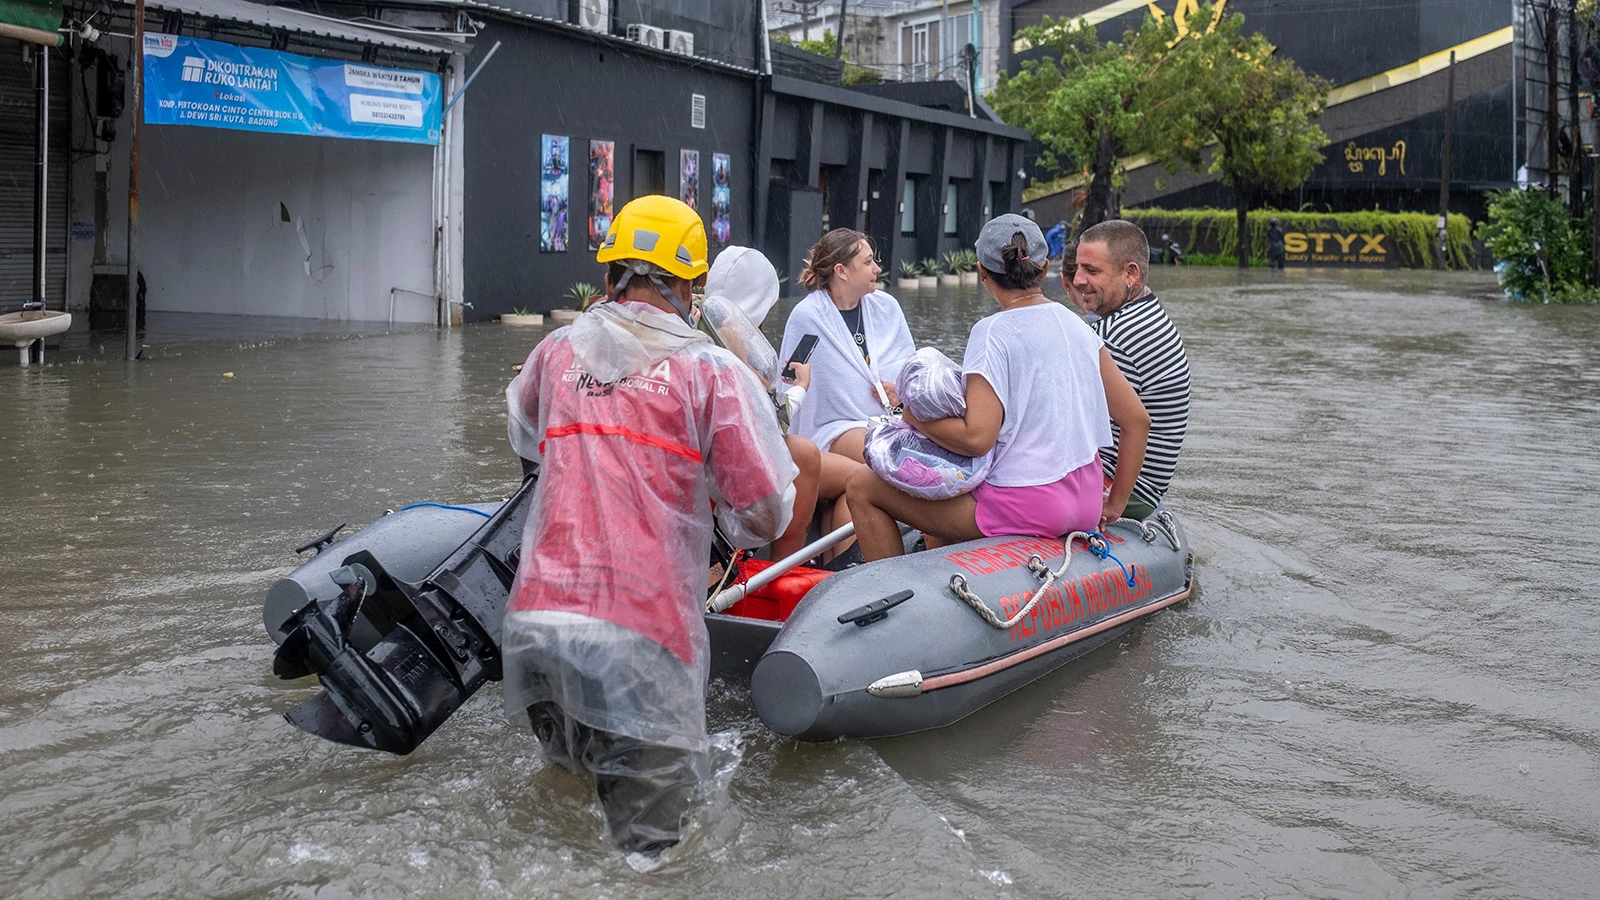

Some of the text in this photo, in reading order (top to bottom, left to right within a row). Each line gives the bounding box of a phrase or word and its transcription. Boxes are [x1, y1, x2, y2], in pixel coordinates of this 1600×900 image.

[207, 60, 278, 80] DIKONTRAKAN
[348, 67, 371, 78] JANGKA
[372, 72, 392, 81] WAKTU
[400, 75, 420, 84] TAHUN
[204, 72, 278, 92] RUKO LANTAI 1
[220, 92, 246, 102] Lokasi
[159, 99, 177, 109] KOMP.
[178, 100, 220, 112] PERTOKOAN
[222, 105, 247, 115] CINTO
[248, 108, 274, 118] CENTER
[275, 110, 292, 120] BLOK
[187, 111, 207, 120] DEWI
[209, 114, 222, 122] SRI
[223, 114, 246, 125] KUTA,
[248, 117, 278, 127] BADUNG
[1284, 232, 1386, 254] STYX
[1285, 254, 1385, 263] Luxury Karaoke and Beyond
[658, 386, 669, 396] RI
[1000, 578, 1086, 642] REPUBLIK
